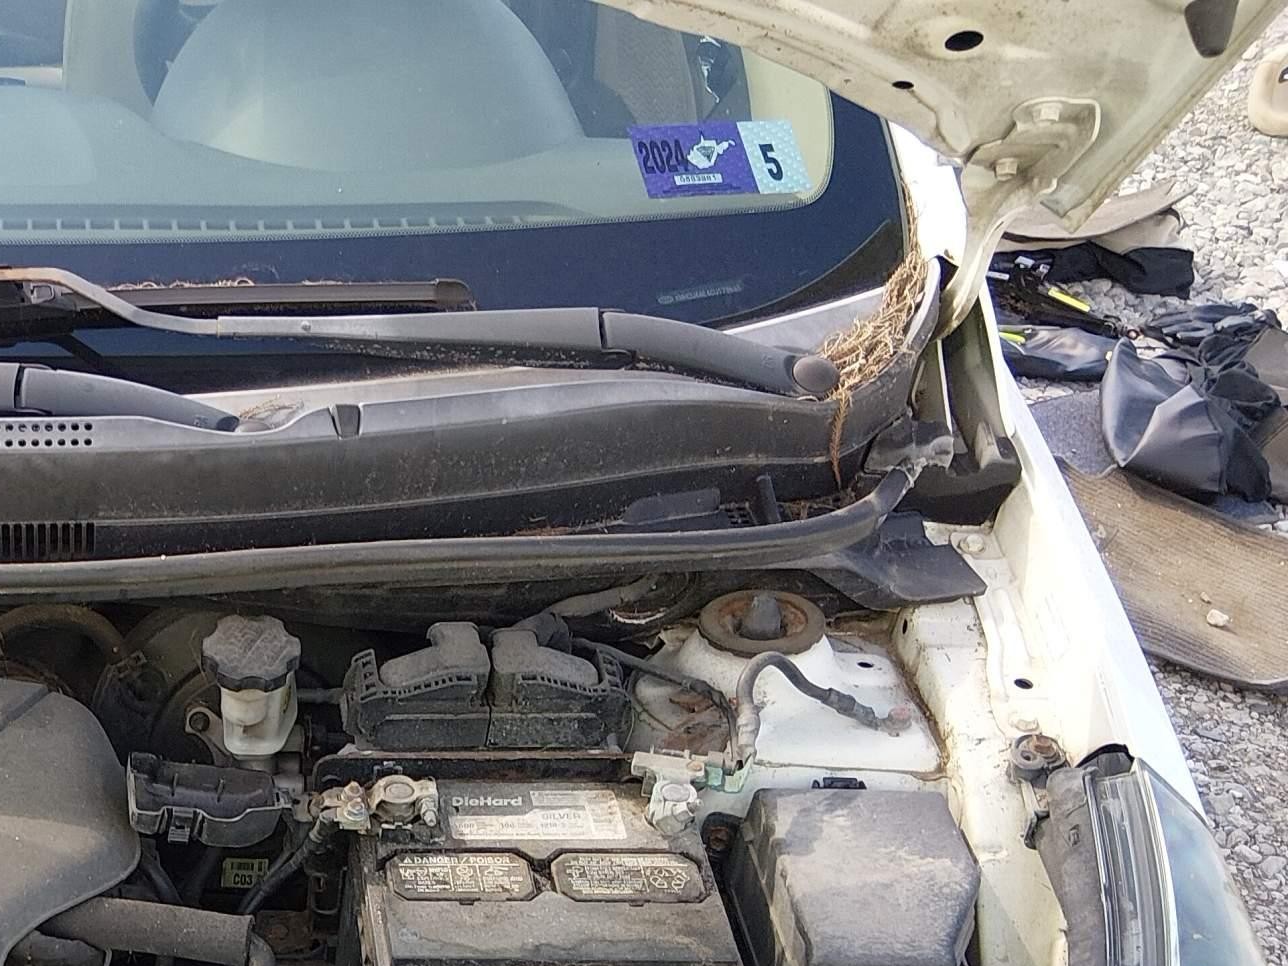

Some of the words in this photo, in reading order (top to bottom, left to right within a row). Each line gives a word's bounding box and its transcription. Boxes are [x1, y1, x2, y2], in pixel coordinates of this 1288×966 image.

[637, 139, 689, 174] 2024
[758, 144, 783, 181] 5
[452, 795, 523, 807] DieHard
[232, 872, 253, 886] C03
